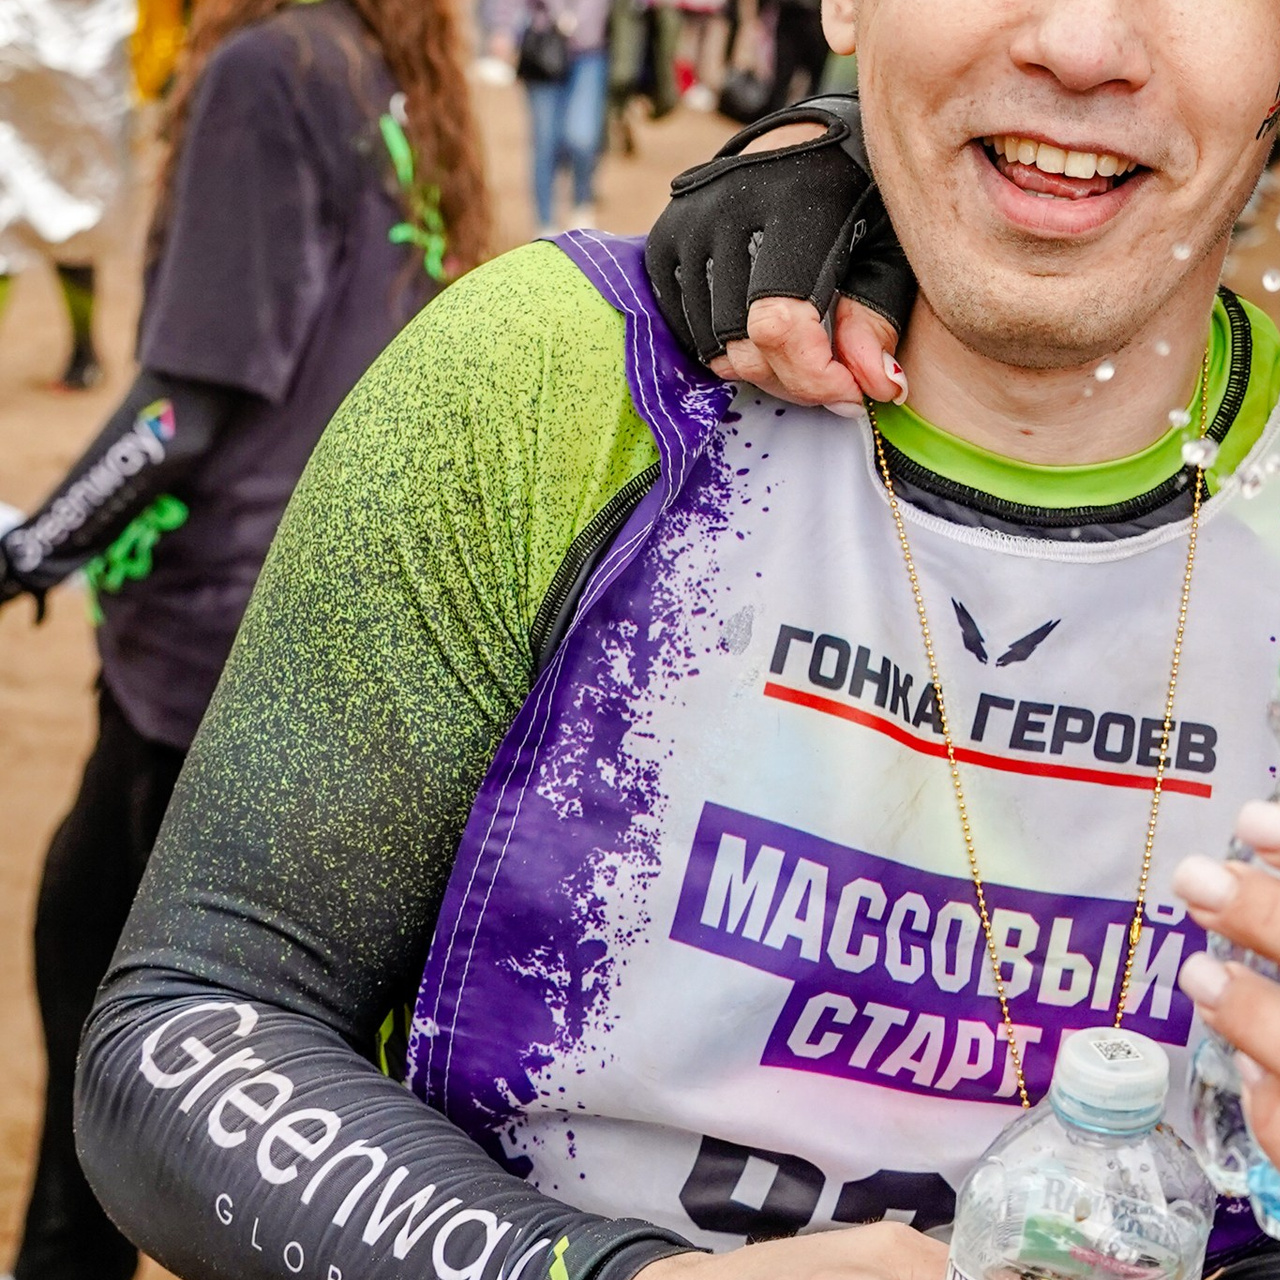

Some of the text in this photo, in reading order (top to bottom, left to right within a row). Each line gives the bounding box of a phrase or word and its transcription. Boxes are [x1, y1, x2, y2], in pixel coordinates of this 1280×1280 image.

[769, 624, 945, 735] ГОНКА
[970, 692, 1217, 774] ГЕРОЕВ
[700, 832, 1188, 1020] МАССОВЫЙ
[786, 992, 1042, 1098] СТАРТ
